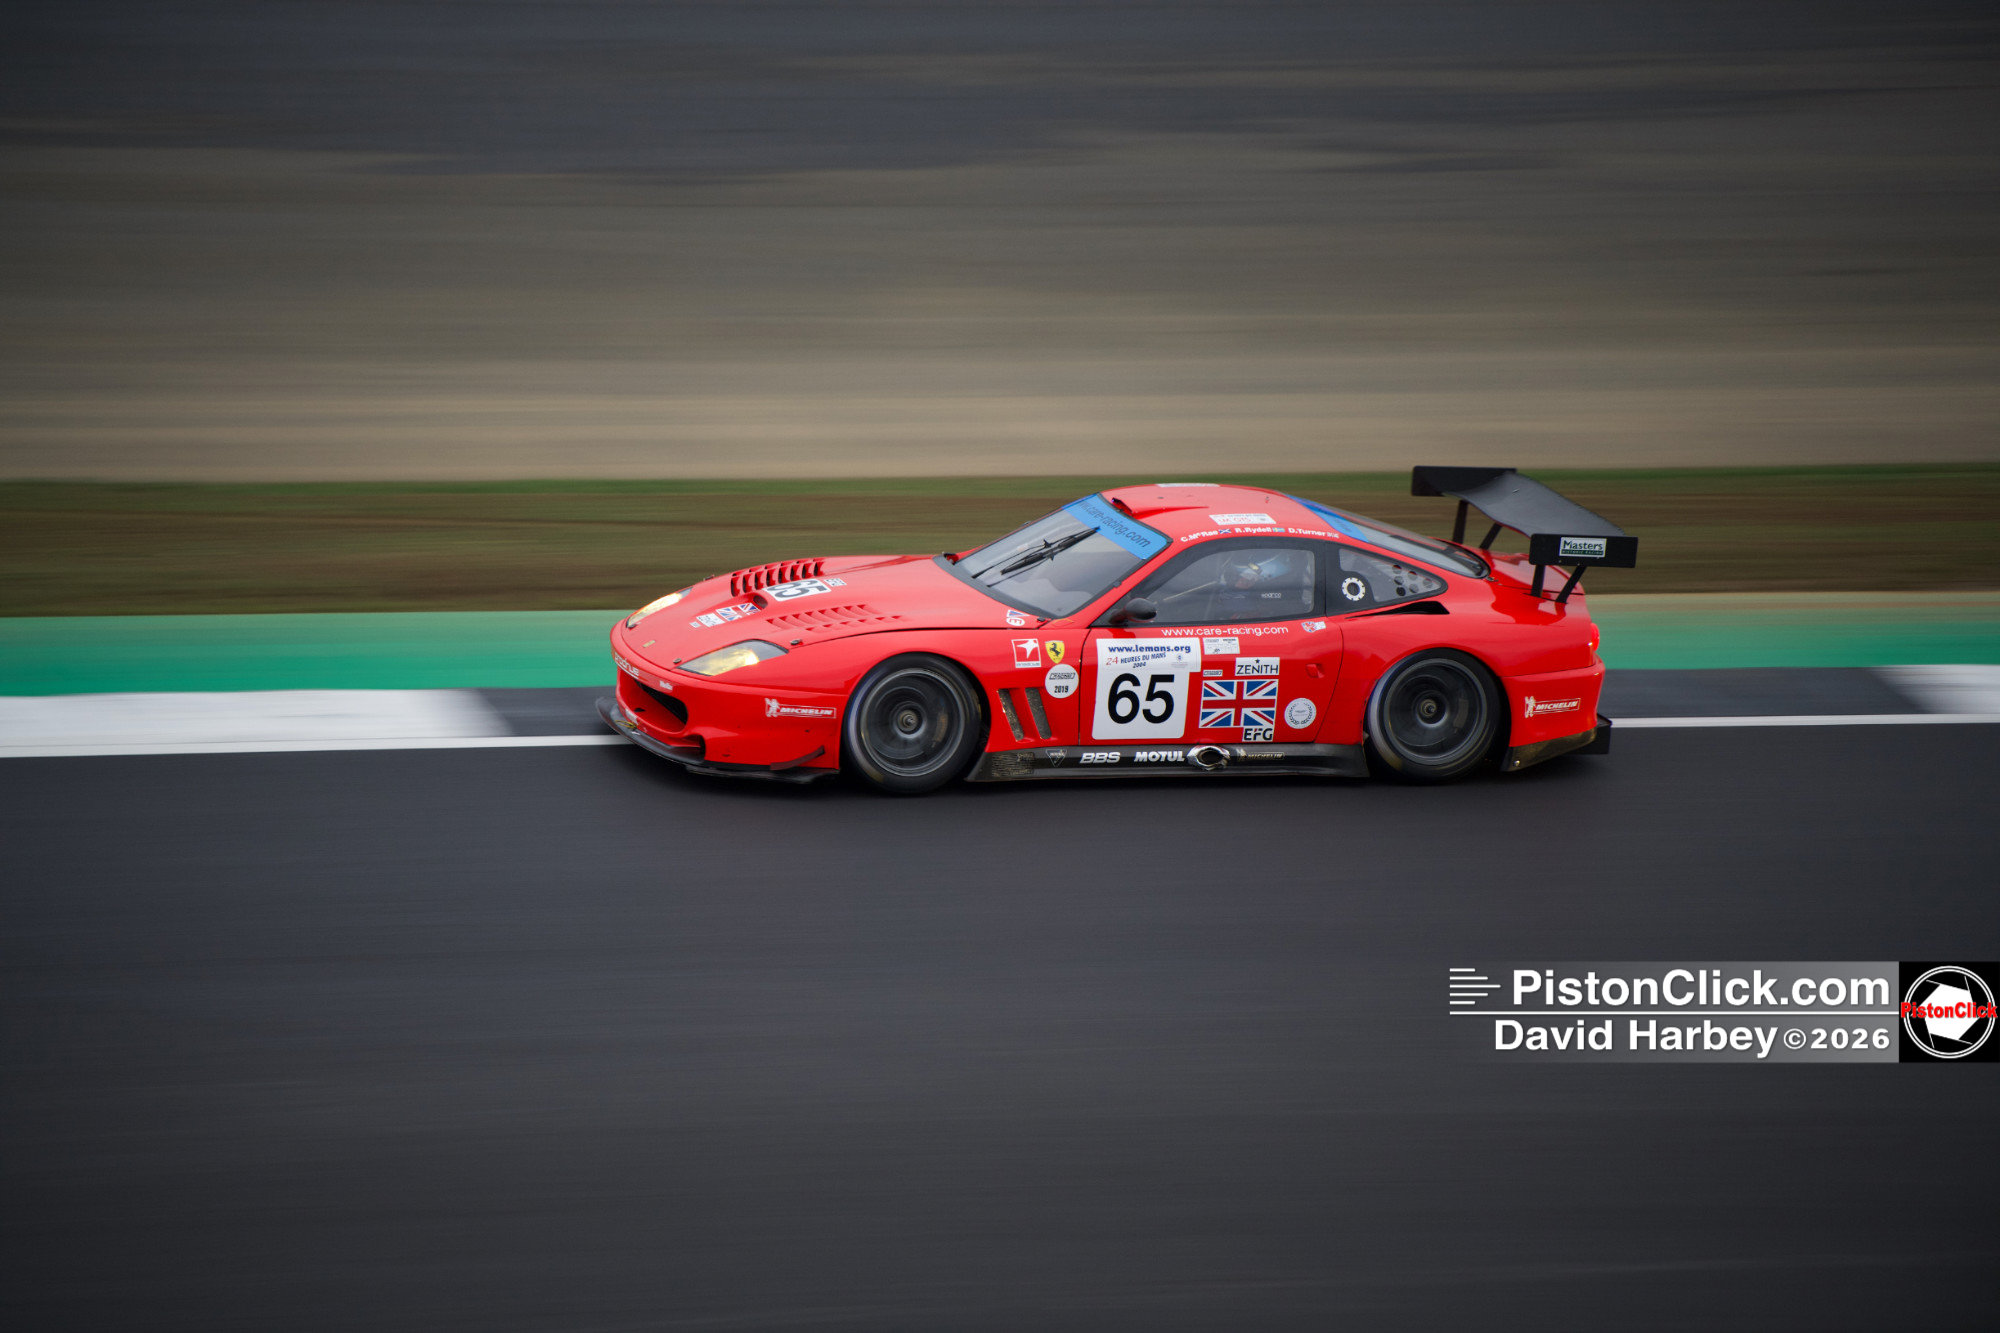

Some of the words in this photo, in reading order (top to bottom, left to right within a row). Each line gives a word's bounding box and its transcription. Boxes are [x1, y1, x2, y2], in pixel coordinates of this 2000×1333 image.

[1288, 528, 1325, 537] D.Turner
[1563, 540, 1603, 550] Masters
[1161, 626, 1288, 637] www.care-racing.com
[1108, 644, 1191, 653] www.lemans.org
[1106, 656, 1119, 666] 24
[1120, 655, 1141, 664] HEURES
[1236, 664, 1279, 674] ZENITH
[1108, 672, 1175, 724] 65
[780, 707, 833, 715] MICHELIN
[1536, 701, 1578, 711] MICHELIN
[1243, 728, 1273, 741] EFG
[1079, 751, 1121, 764] BBS
[1134, 750, 1185, 762] MOTUL
